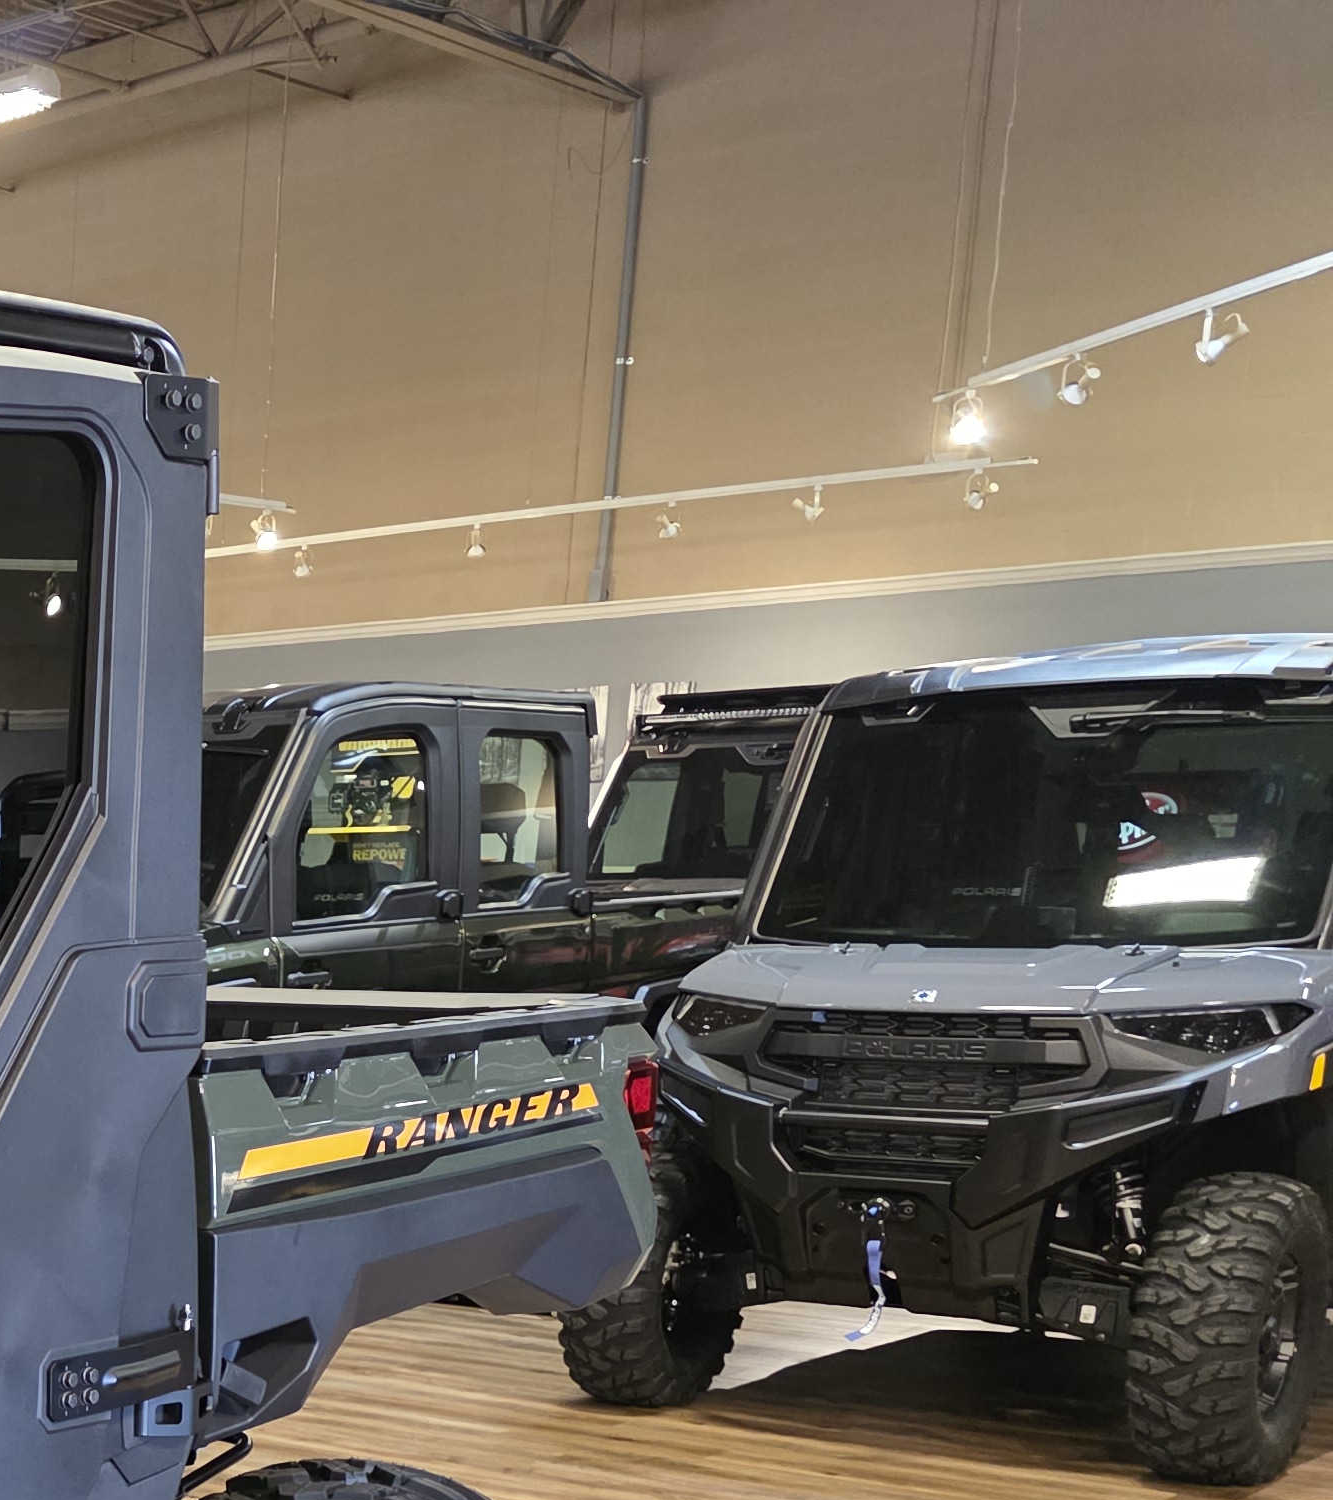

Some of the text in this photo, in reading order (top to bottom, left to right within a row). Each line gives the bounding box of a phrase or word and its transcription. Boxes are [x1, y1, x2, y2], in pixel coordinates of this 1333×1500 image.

[952, 887, 1022, 897] POLARIS
[843, 1038, 987, 1061] POLARIS
[362, 1083, 581, 1160] RANGER
